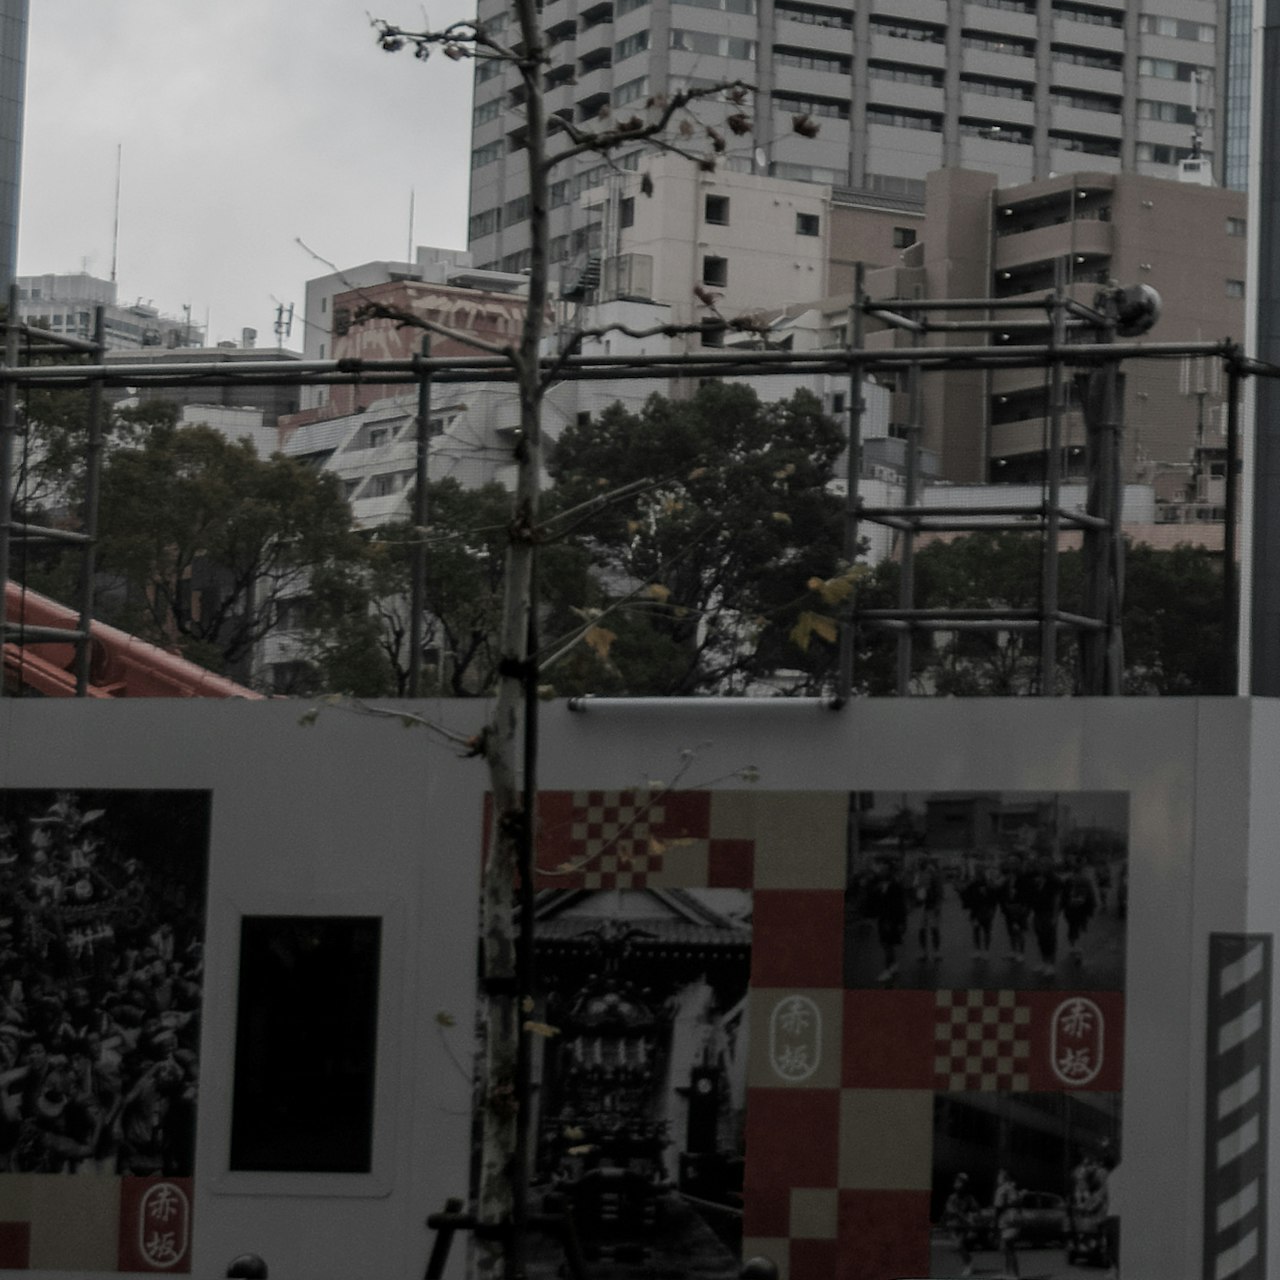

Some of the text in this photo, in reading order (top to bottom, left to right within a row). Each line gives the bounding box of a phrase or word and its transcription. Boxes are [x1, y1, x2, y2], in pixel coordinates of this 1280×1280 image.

[778, 998, 812, 1072] 赤坂
[1059, 999, 1092, 1076] 赤坂
[146, 1186, 178, 1258] 赤坂
